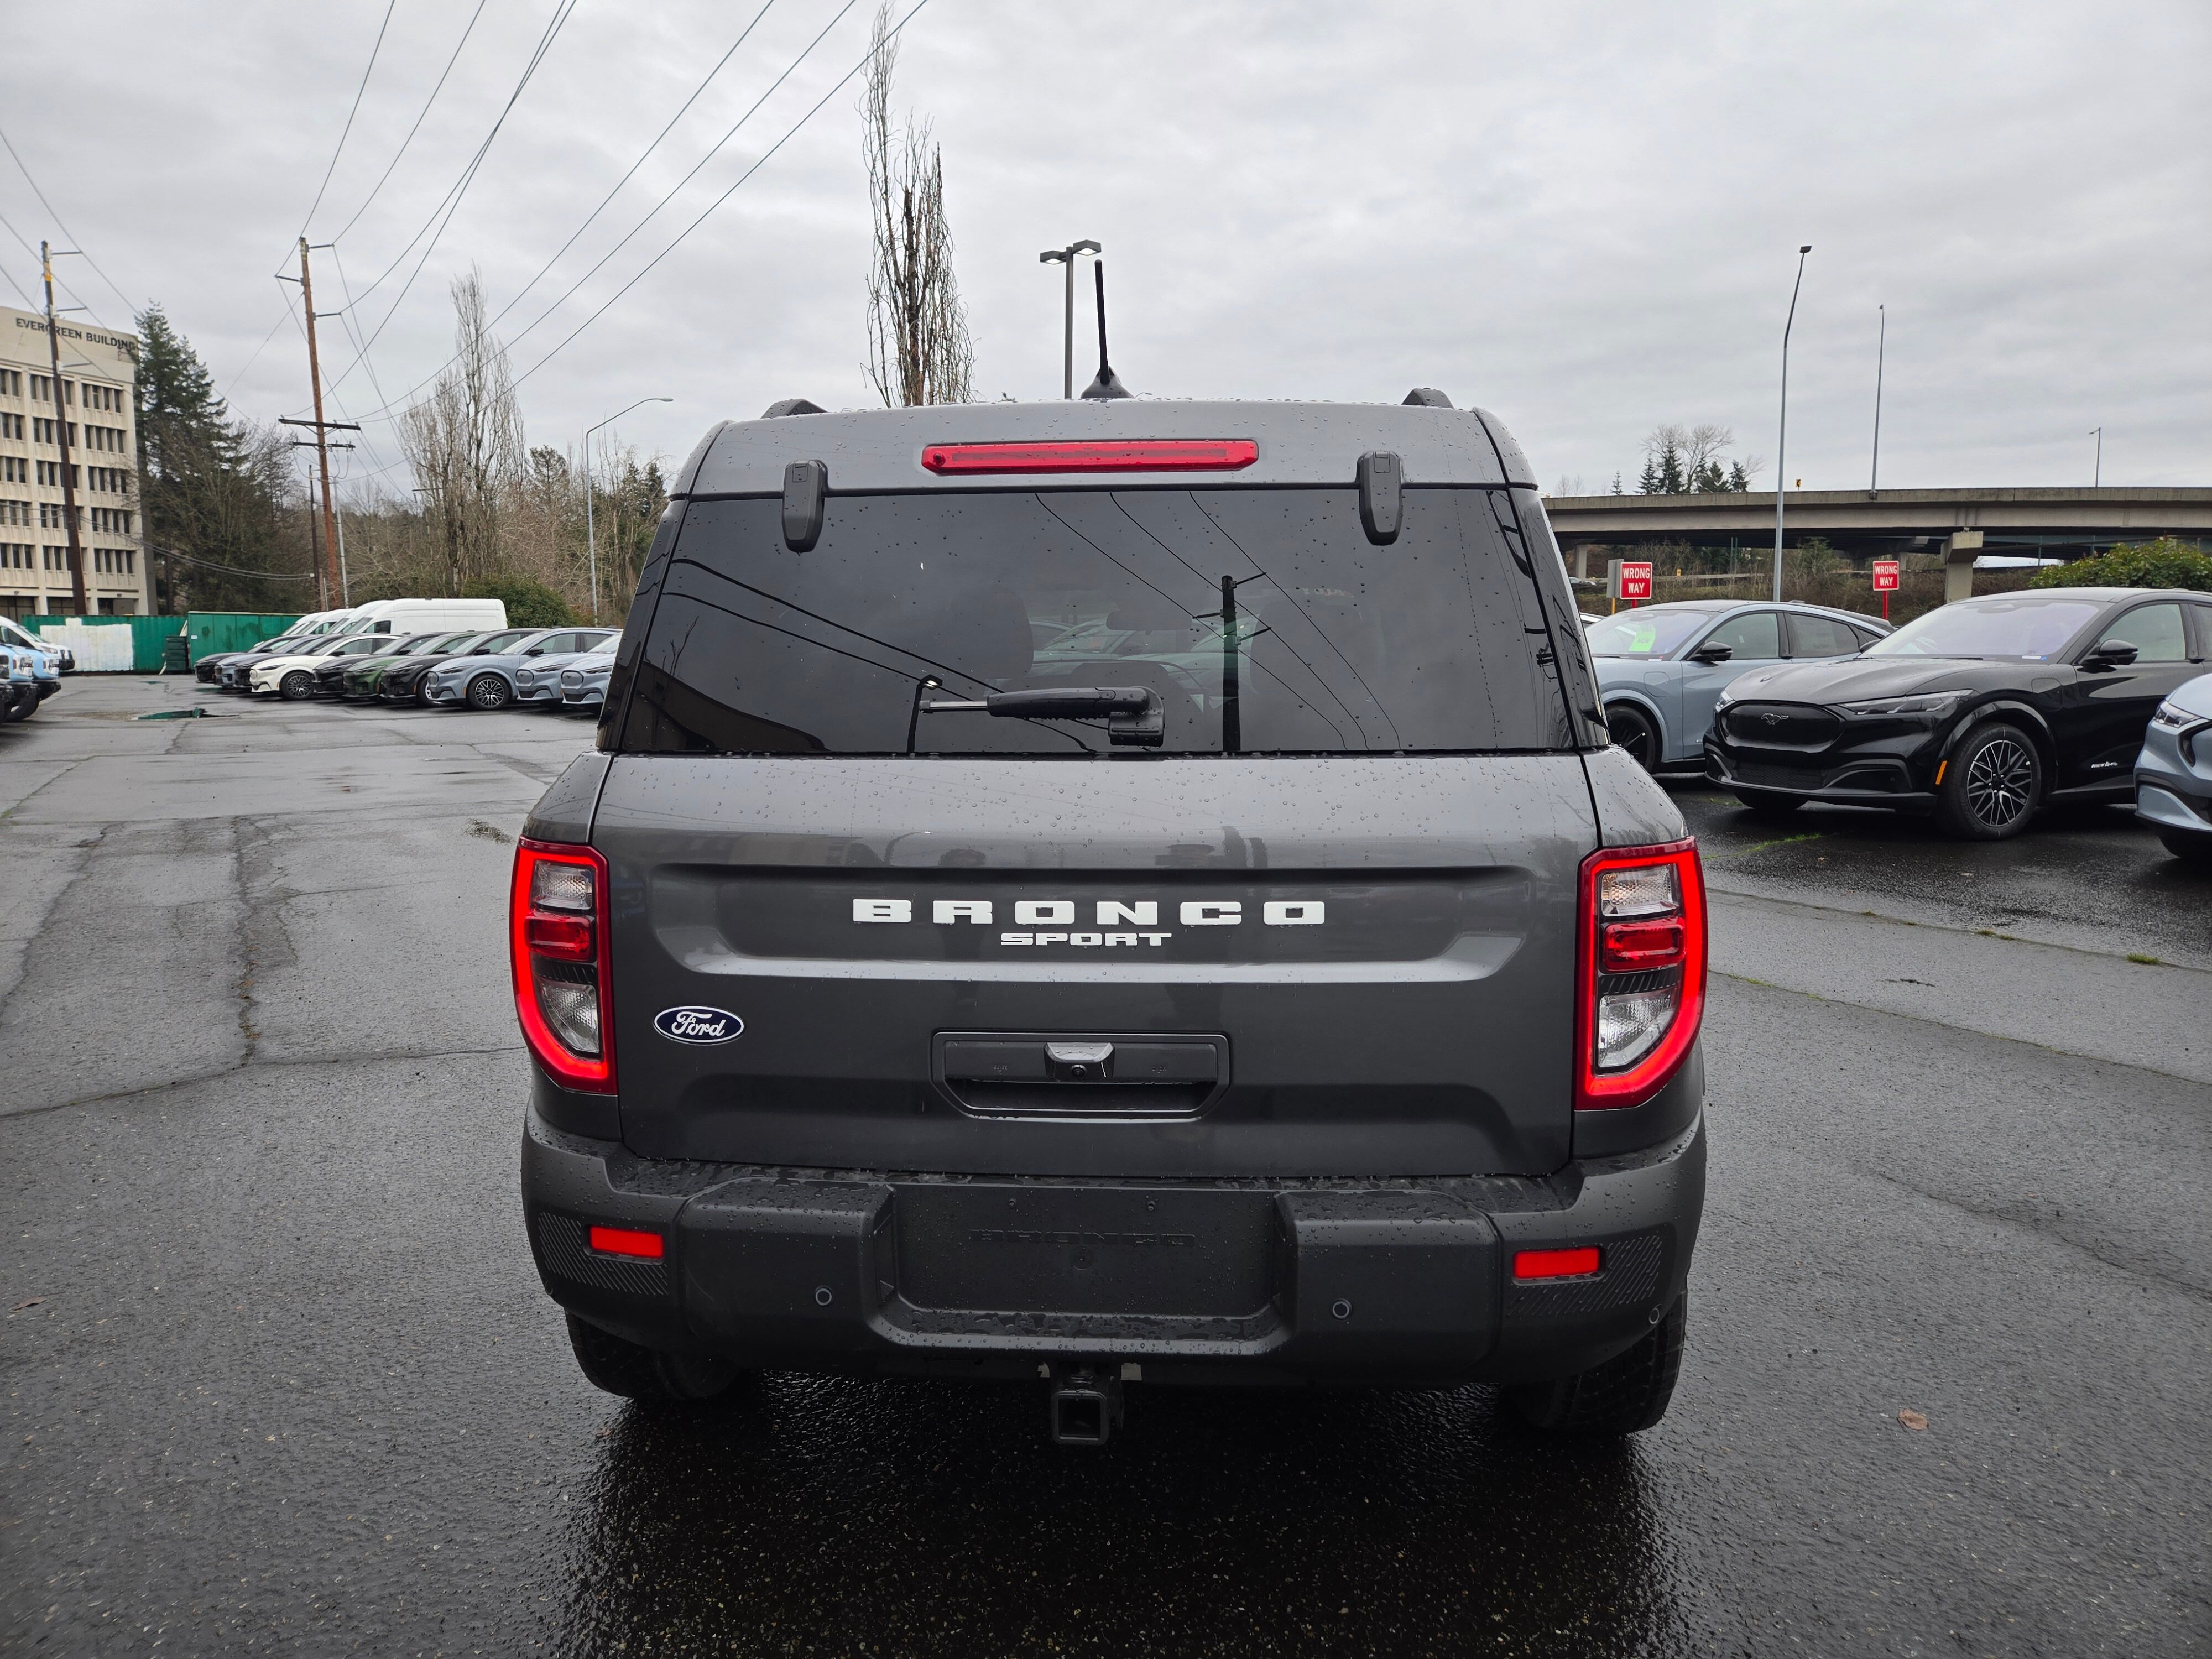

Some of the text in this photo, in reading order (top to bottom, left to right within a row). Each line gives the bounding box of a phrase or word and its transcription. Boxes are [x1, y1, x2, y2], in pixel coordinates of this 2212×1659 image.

[86, 332, 135, 350] BUILDING
[1623, 567, 1650, 579] WRONG
[1875, 565, 1897, 575] WRONG
[1628, 582, 1645, 594] WAY
[1880, 577, 1893, 586] WAY
[853, 899, 1325, 925] BRONCO
[1001, 932, 1172, 946] SPORT
[671, 1011, 726, 1036] Ford
